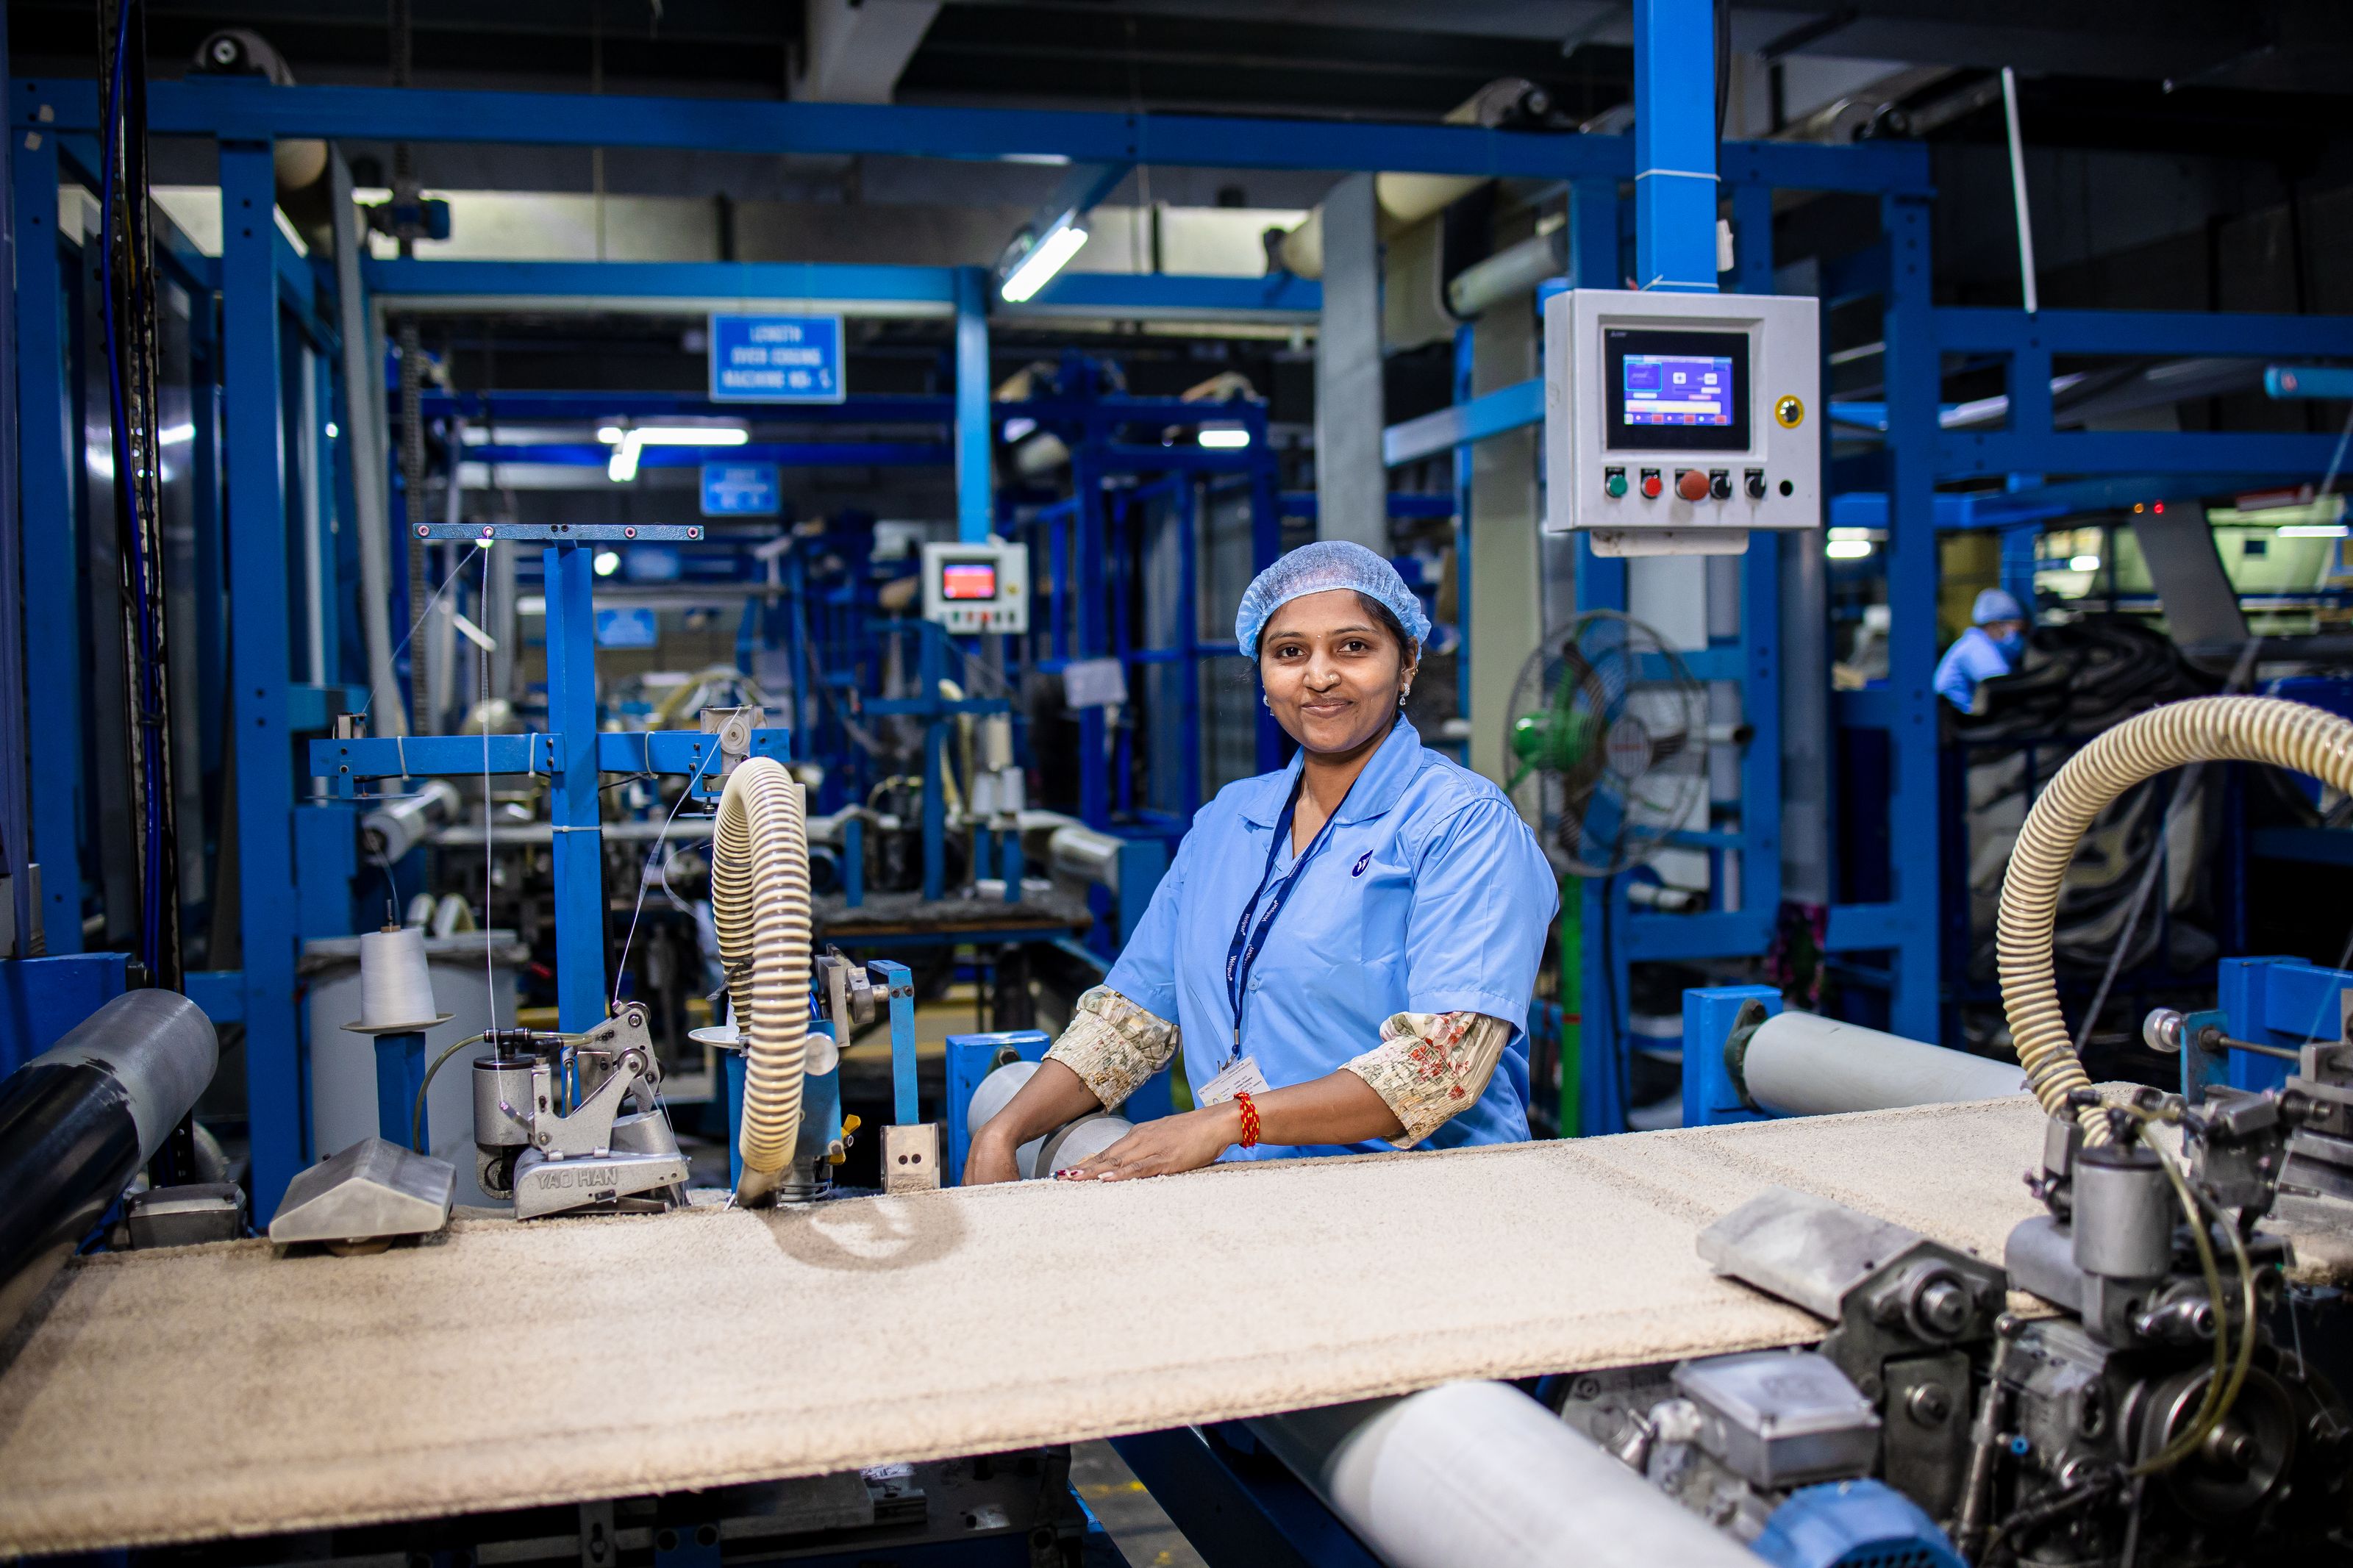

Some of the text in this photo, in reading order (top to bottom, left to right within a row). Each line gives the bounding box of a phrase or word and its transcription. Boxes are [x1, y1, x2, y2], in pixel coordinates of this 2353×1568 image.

[1261, 901, 1279, 922] Welspun
[1227, 955, 1238, 980] Welspun
[535, 1167, 618, 1189] YAO HAN
